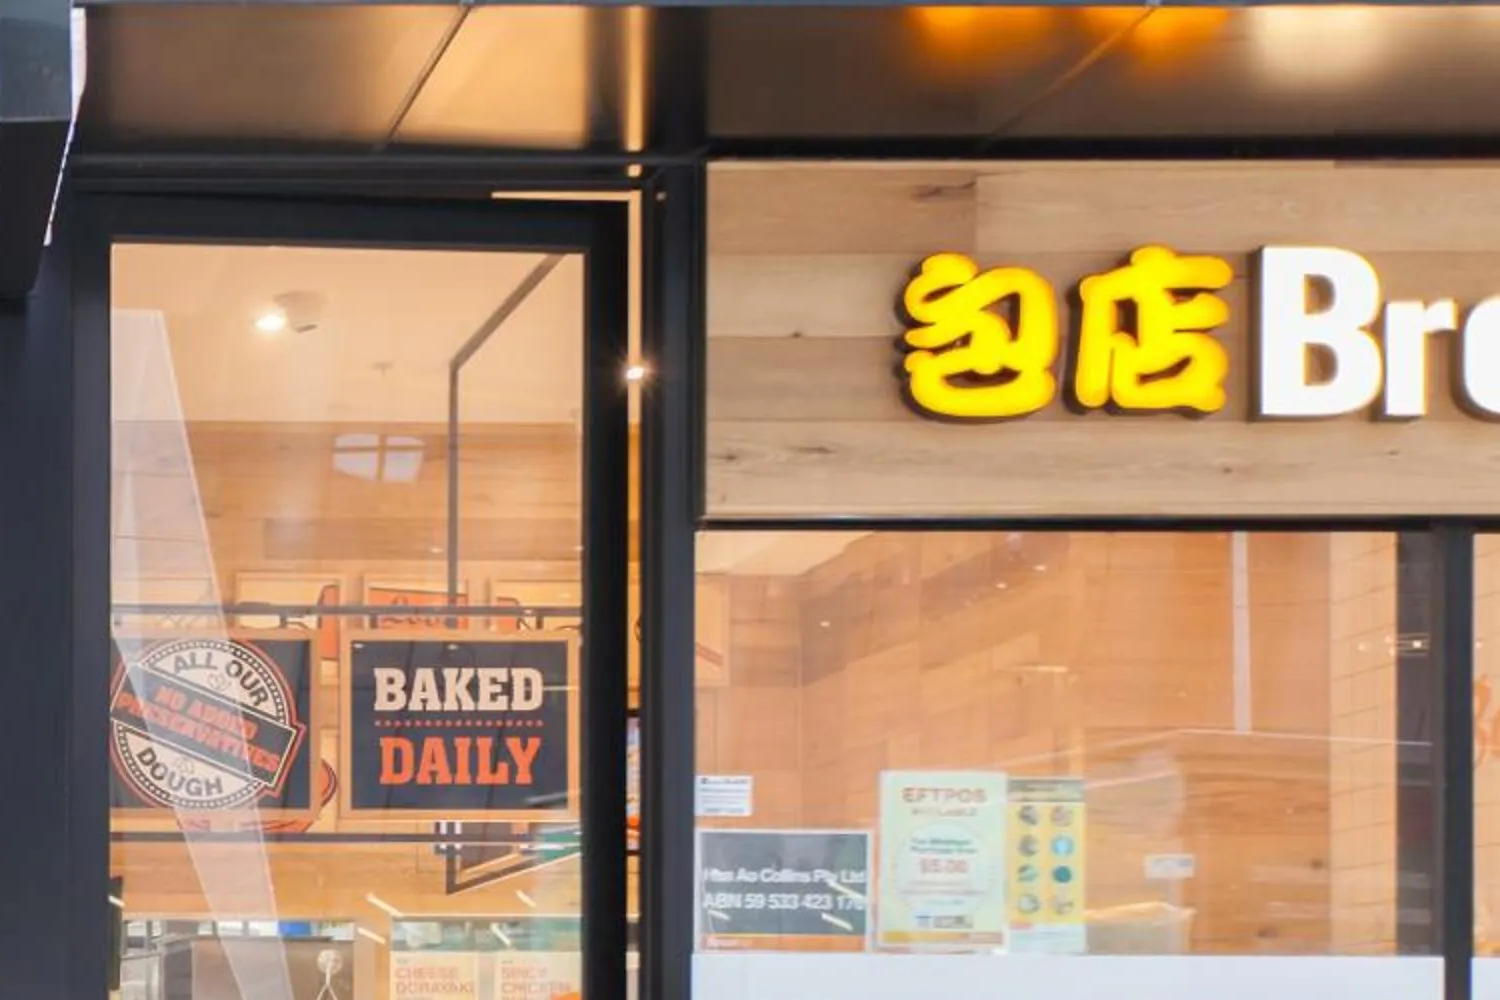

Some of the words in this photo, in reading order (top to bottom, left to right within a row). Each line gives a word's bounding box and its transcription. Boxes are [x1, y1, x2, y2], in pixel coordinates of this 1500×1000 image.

[172, 651, 218, 675] ALL
[226, 660, 269, 707] OUR
[373, 667, 544, 711] BAKED
[136, 746, 224, 797] DOUGH
[379, 736, 542, 786] DAILY
[901, 786, 988, 803] EFTPOS
[760, 867, 811, 883] Collins
[703, 892, 743, 909] ABN
